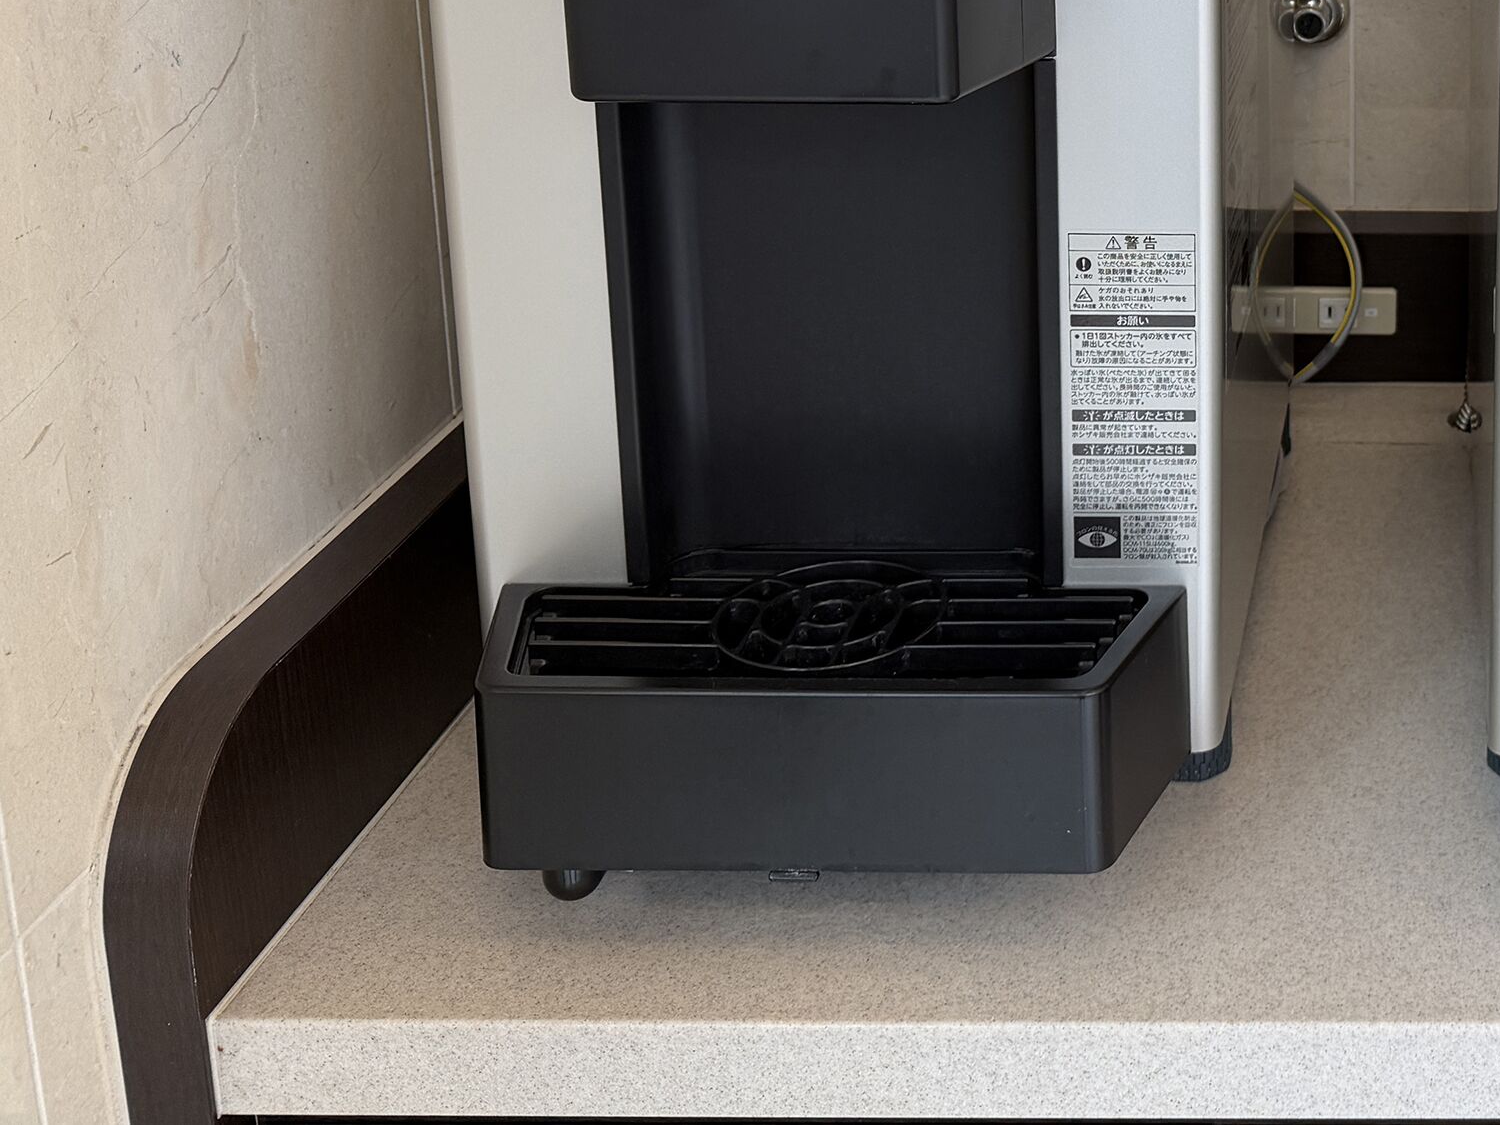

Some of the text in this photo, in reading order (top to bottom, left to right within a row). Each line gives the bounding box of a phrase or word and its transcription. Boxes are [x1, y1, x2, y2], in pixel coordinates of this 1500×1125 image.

[1124, 235, 1157, 250] 警告
[1116, 315, 1149, 326] お願い
